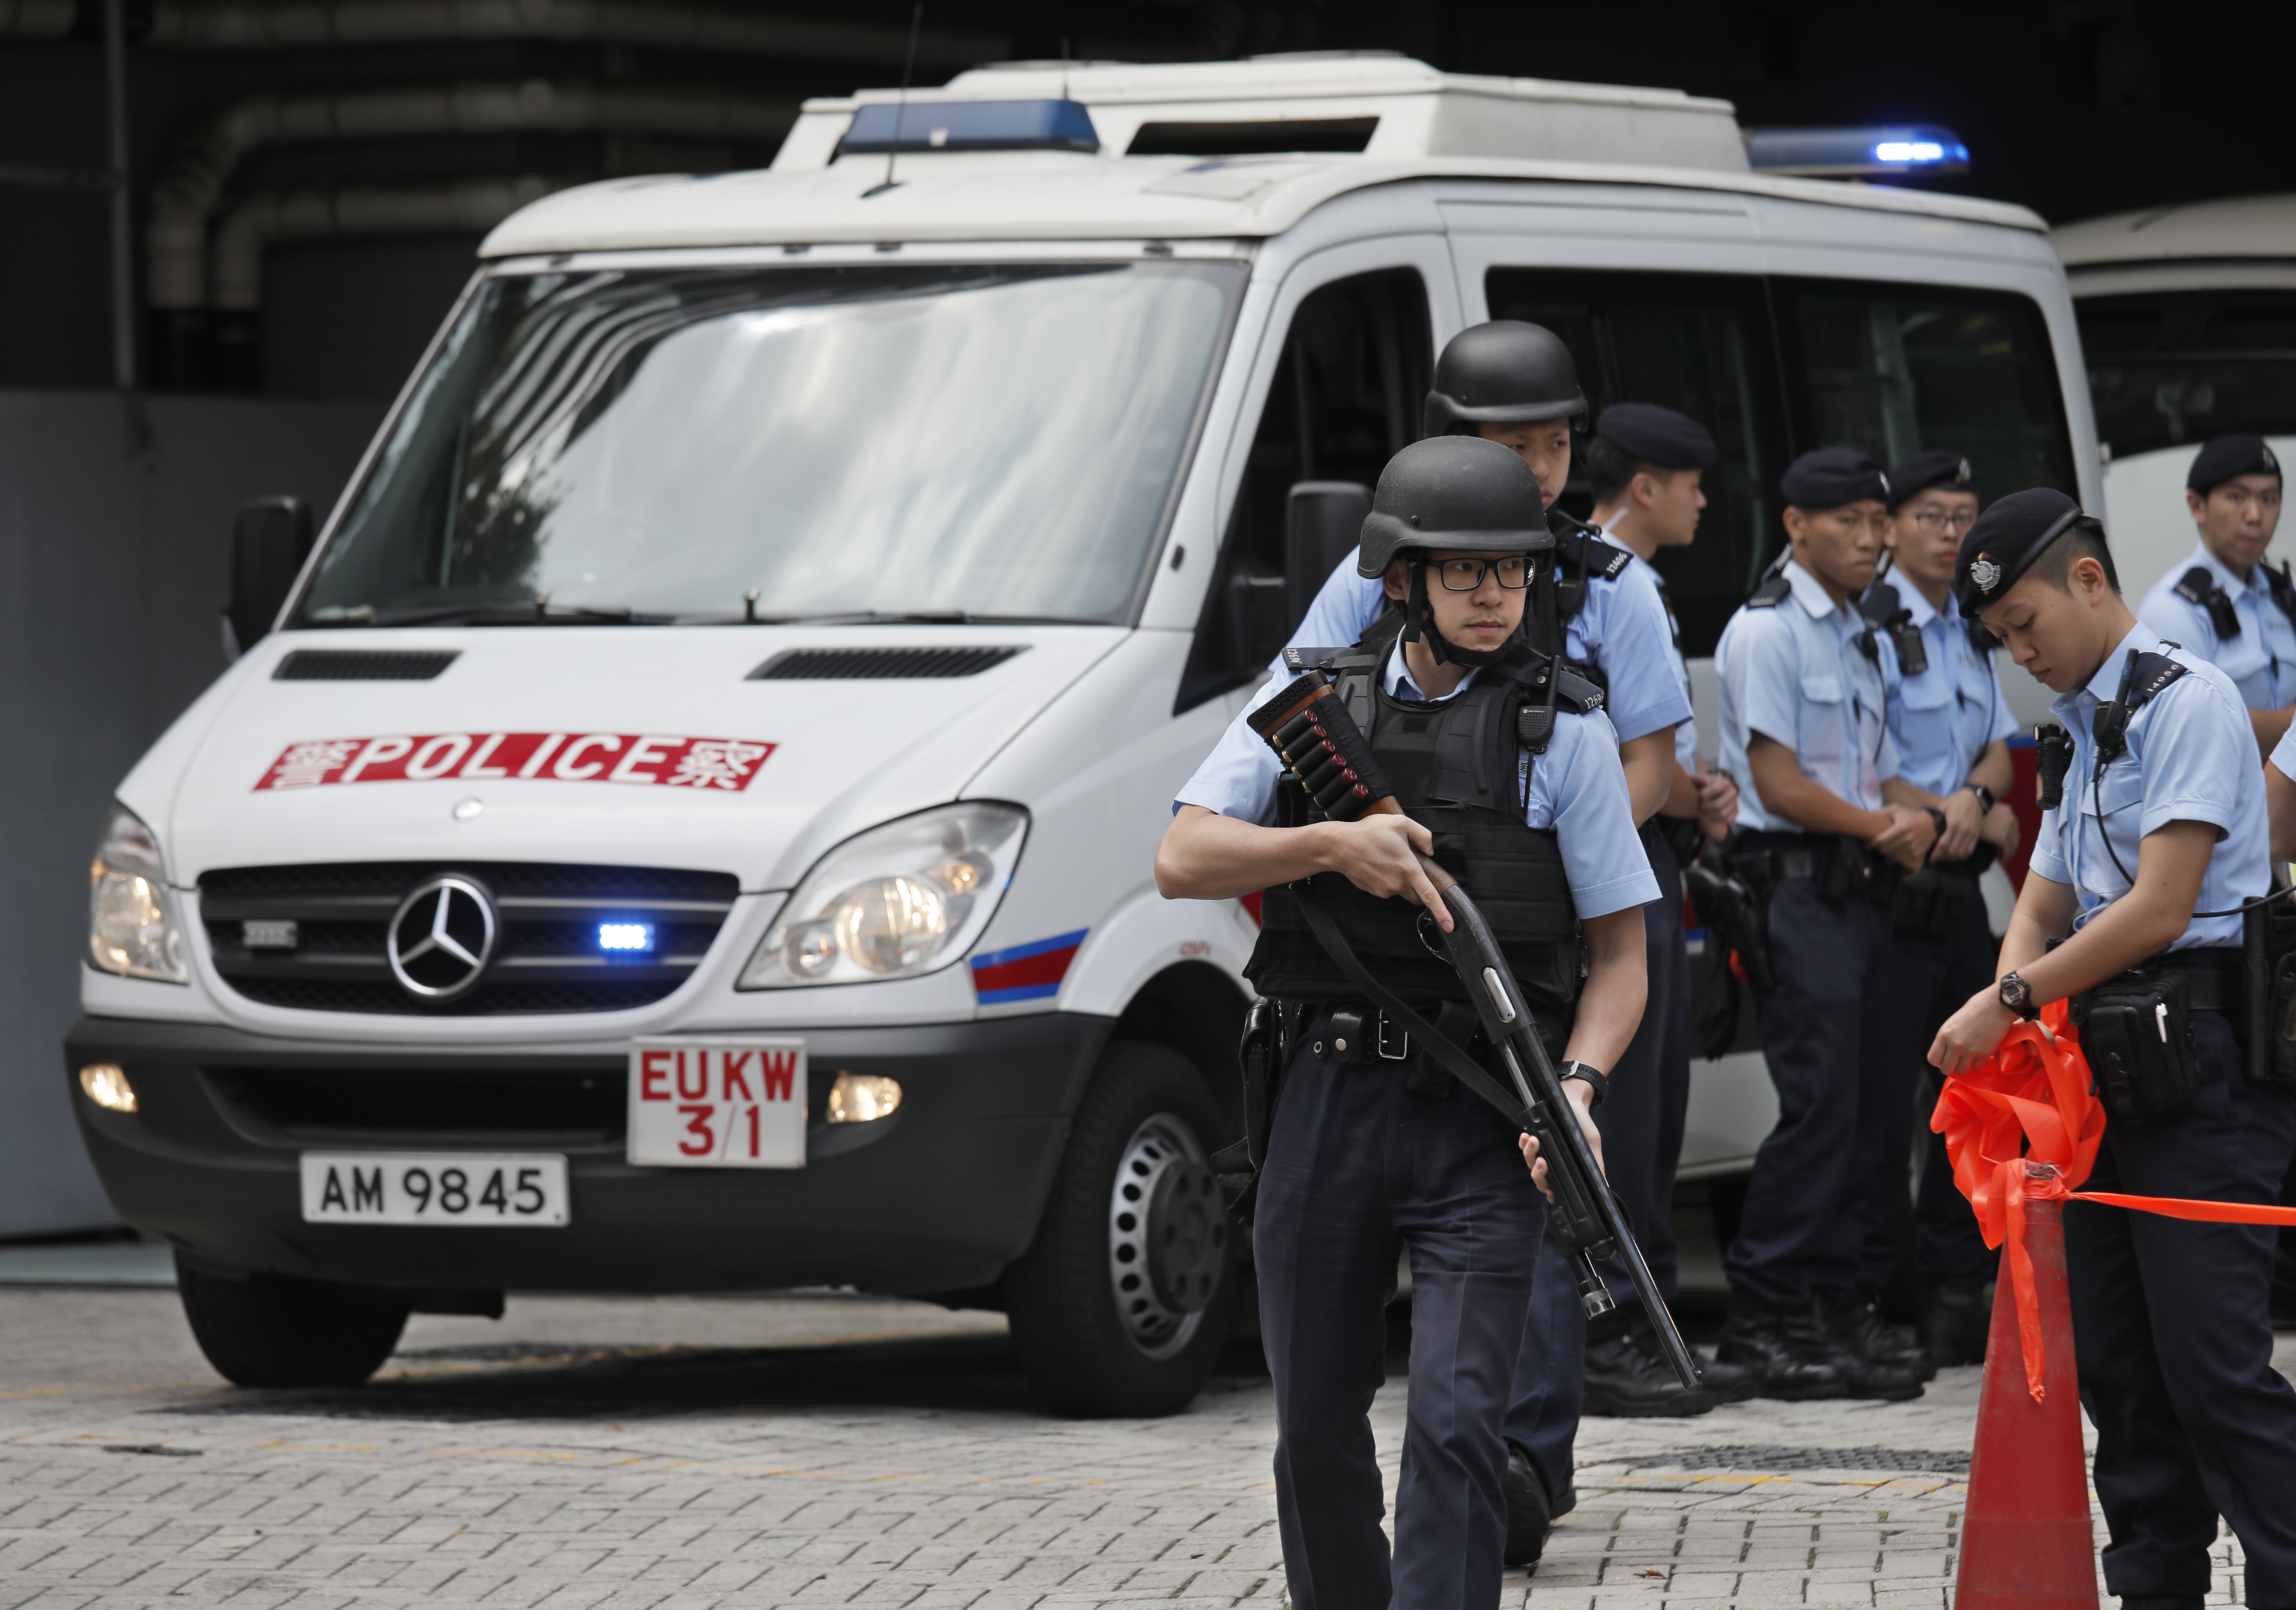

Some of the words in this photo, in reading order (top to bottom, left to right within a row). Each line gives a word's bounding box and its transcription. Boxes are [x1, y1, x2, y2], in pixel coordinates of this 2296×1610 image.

[1286, 649, 1302, 663] 12696
[2147, 664, 2179, 691] 14956
[339, 733, 687, 783] POLICE
[321, 1166, 384, 1212] AM
[403, 1169, 545, 1214] 9845
